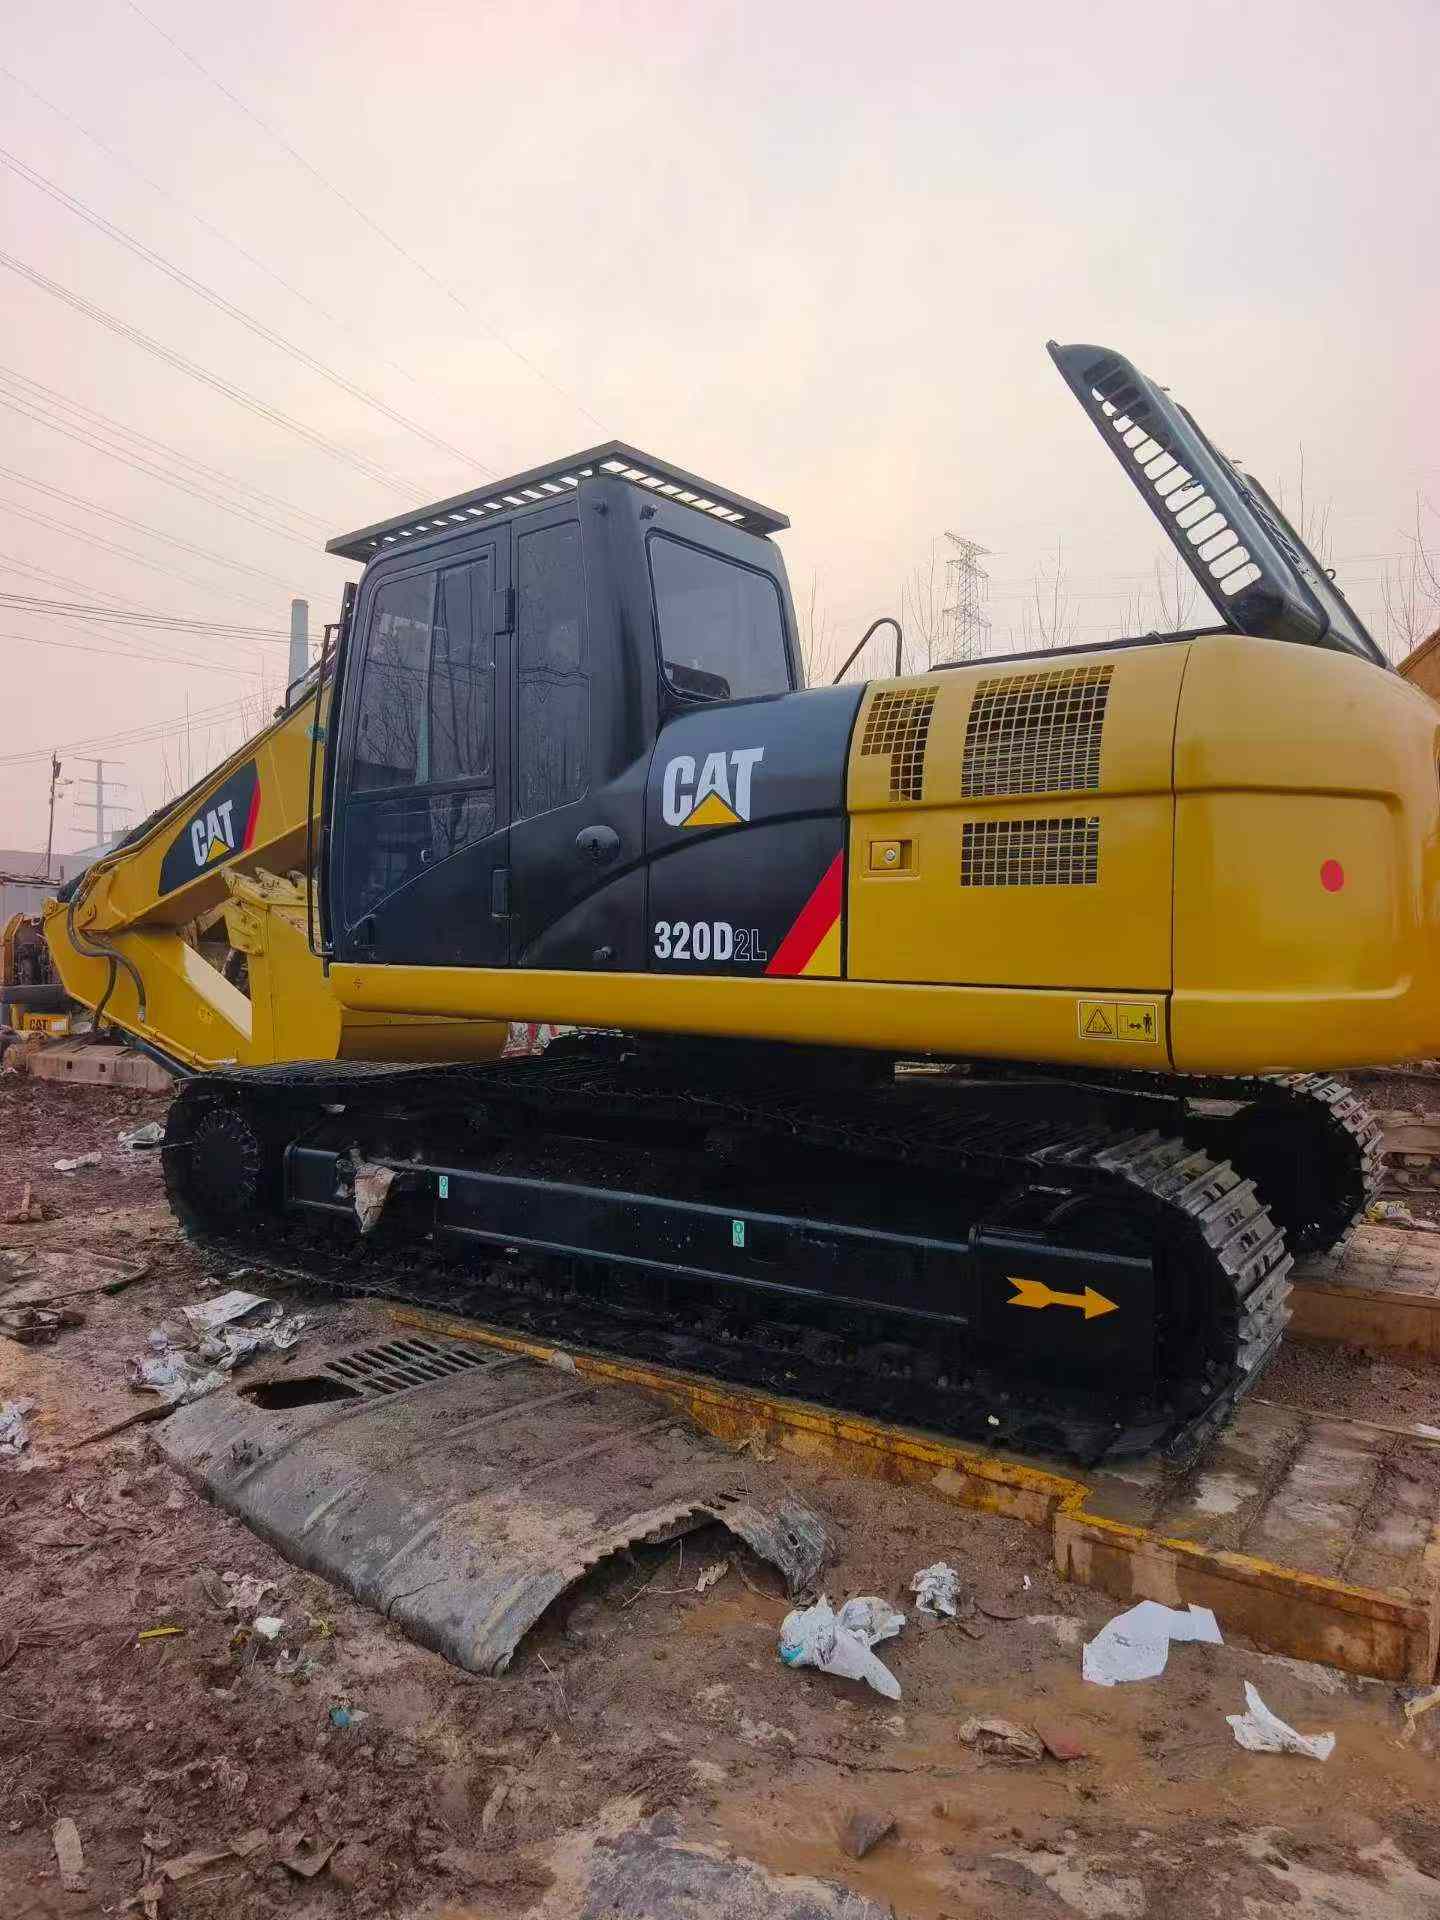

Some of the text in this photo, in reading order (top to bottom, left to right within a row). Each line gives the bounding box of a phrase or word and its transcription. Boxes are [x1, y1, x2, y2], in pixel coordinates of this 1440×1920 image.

[662, 747, 764, 827] CAT
[191, 800, 235, 867] CAT
[654, 921, 767, 961] 320D2L
[30, 1019, 48, 1031] CAT
